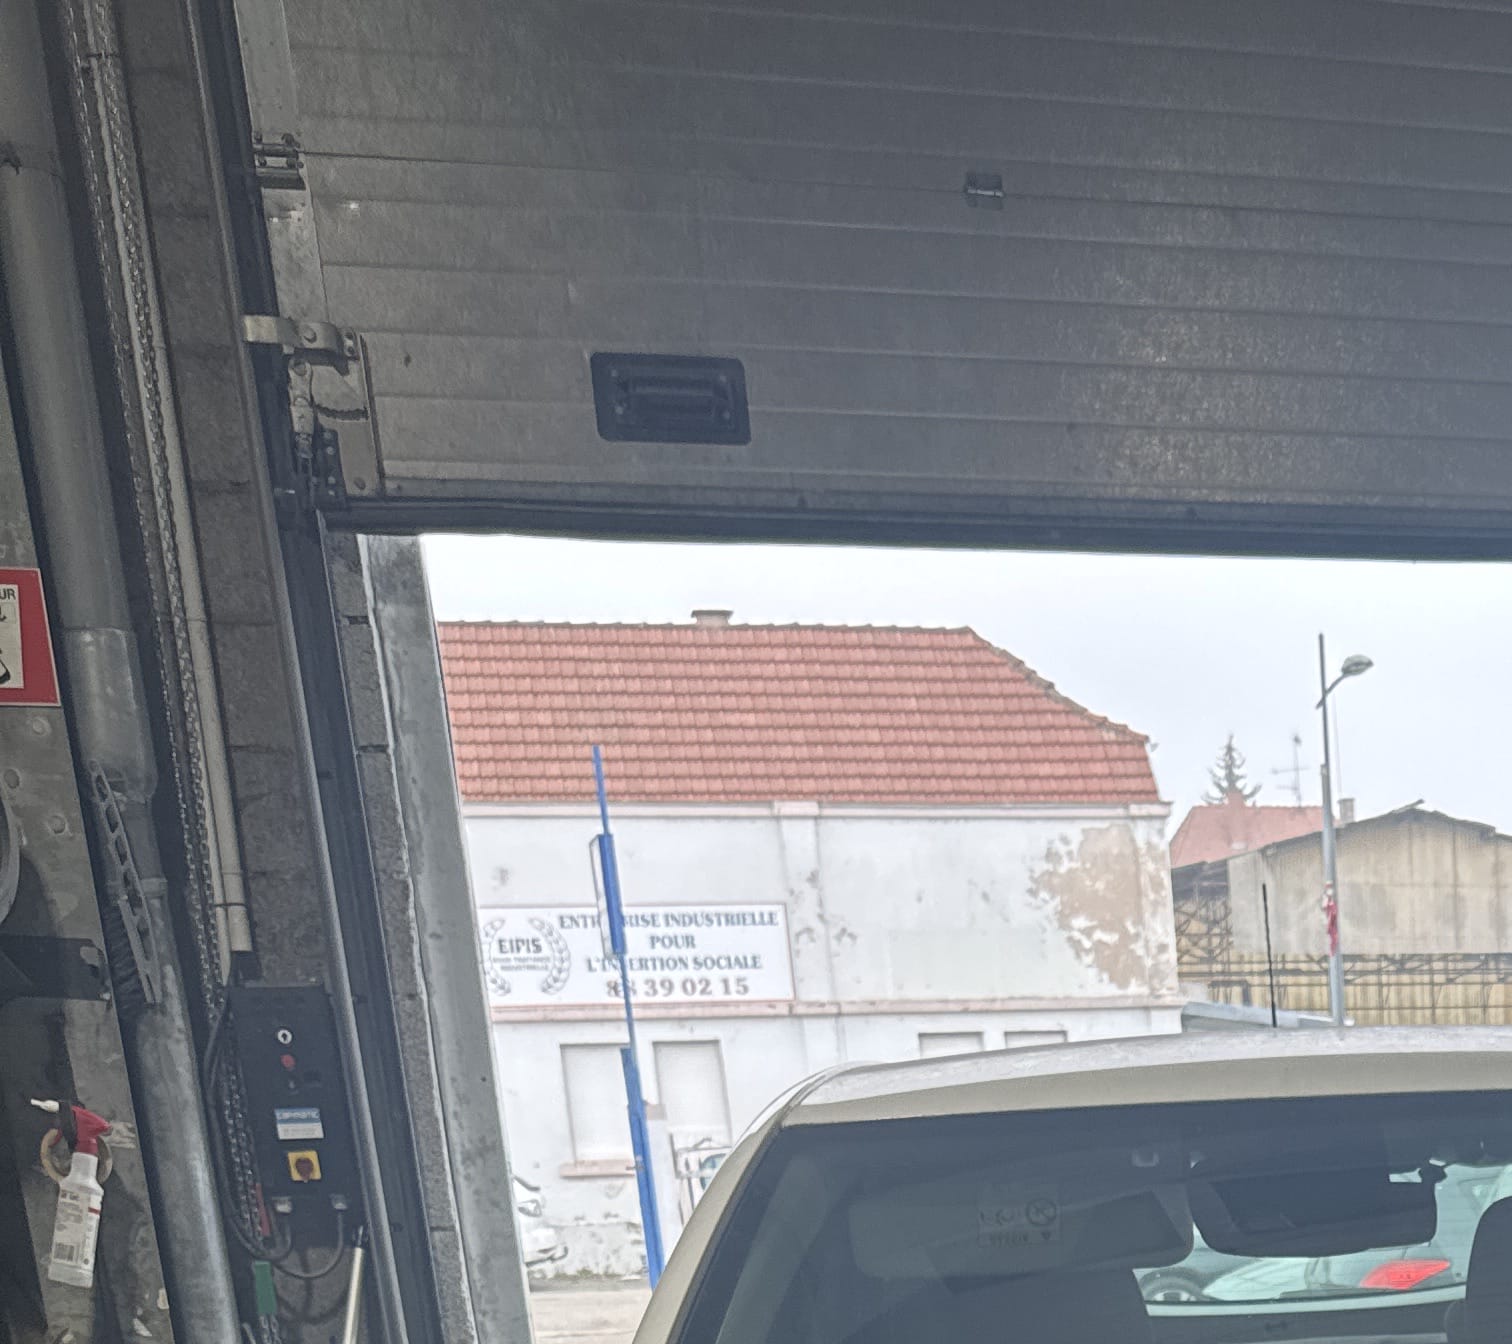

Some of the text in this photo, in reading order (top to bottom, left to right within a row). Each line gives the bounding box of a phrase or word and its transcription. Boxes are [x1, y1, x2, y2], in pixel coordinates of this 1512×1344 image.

[559, 911, 779, 929] ENTRRISE INDUSTRIELLE
[498, 937, 542, 954] EIPIS
[649, 935, 696, 950] POUR
[587, 955, 763, 972] L'INERTION SOCIALE
[644, 979, 674, 997] 39
[682, 978, 712, 996] 02
[723, 977, 750, 995] 15
